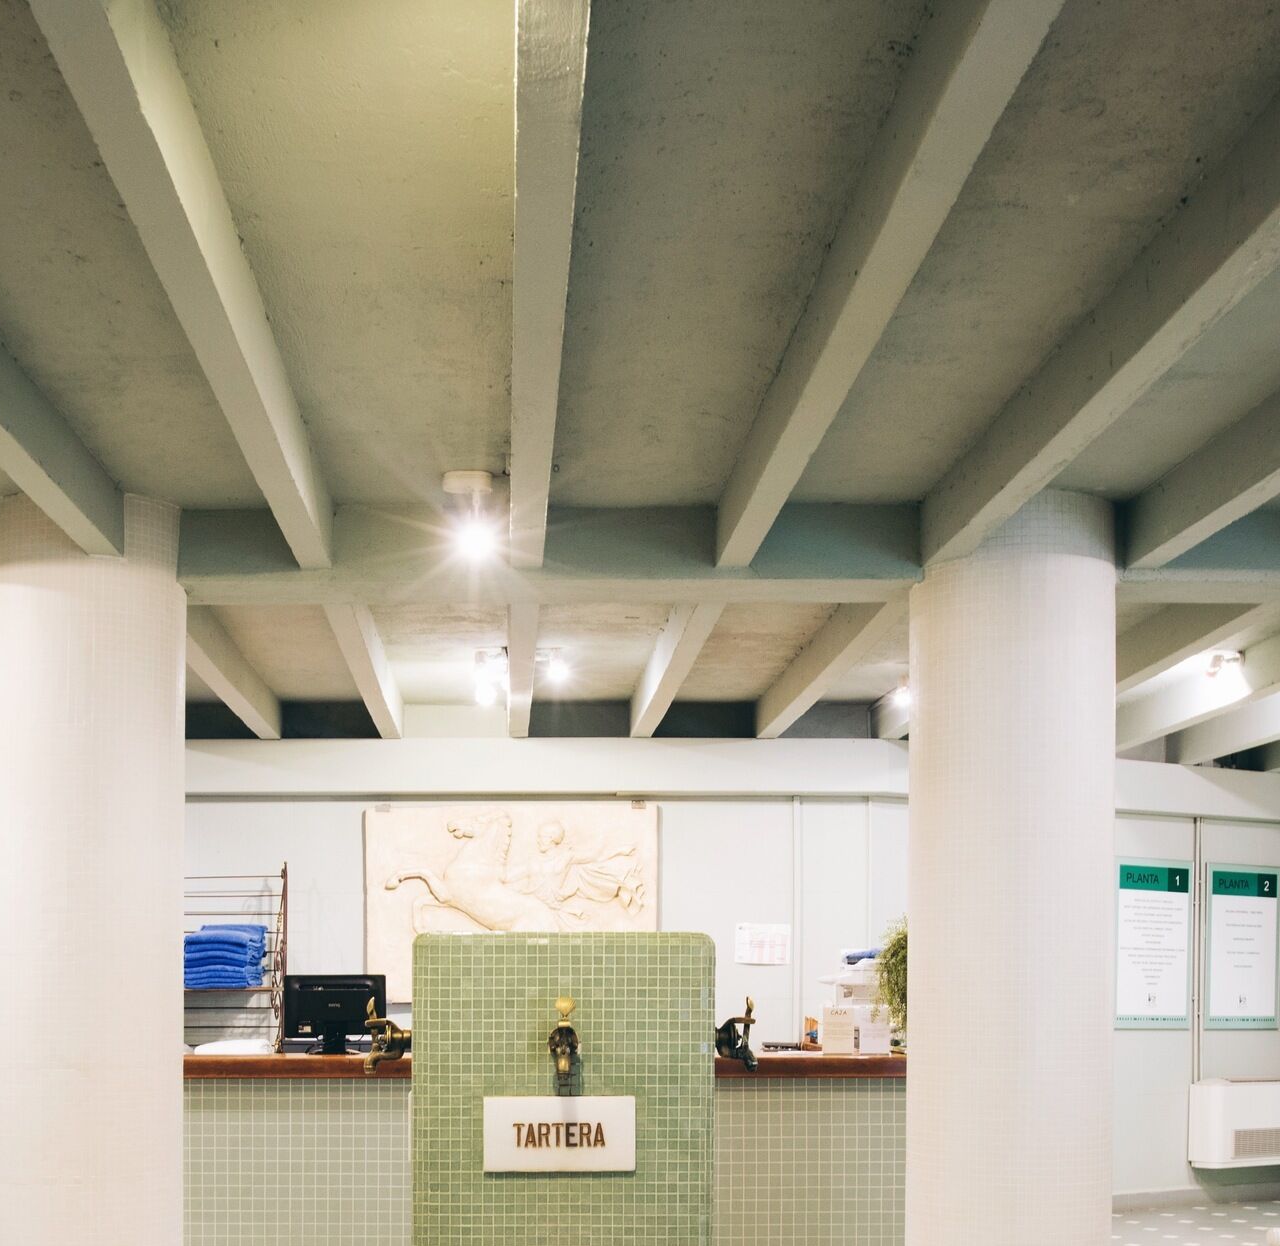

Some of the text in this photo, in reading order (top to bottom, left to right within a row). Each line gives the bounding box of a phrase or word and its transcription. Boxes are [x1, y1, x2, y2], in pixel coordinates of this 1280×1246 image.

[1126, 872, 1180, 886] PLANTA 1
[1218, 878, 1270, 891] PLANTA 2
[512, 1122, 605, 1148] TARTERA
